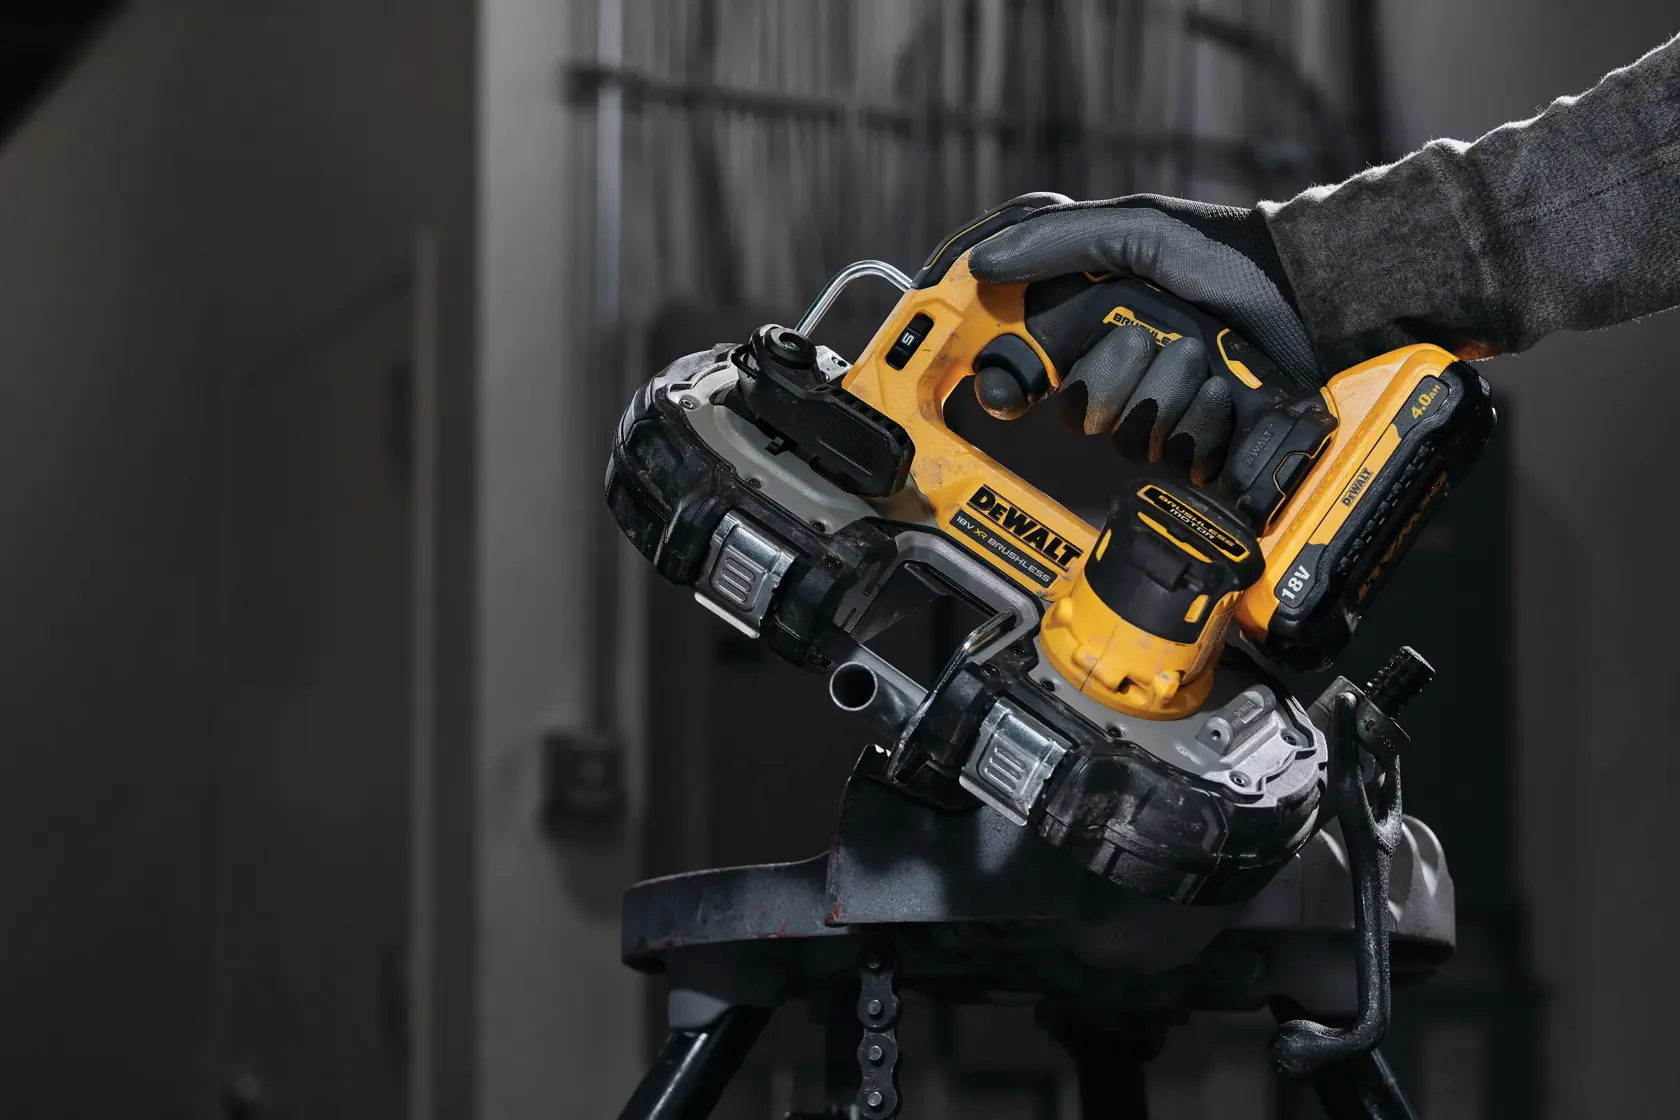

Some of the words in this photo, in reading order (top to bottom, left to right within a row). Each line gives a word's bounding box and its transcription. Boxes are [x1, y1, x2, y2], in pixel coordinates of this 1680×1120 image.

[1241, 429, 1275, 467] DEWALT
[1342, 467, 1372, 507] DEWALT
[969, 485, 1082, 567] DEWALT
[1158, 494, 1235, 547] BRUSHLESS
[1169, 508, 1215, 539] MOTOR
[956, 515, 975, 531] 18V
[973, 527, 989, 540] XR
[987, 537, 1051, 582] BRUSHLESS
[1281, 564, 1310, 600] 18V
